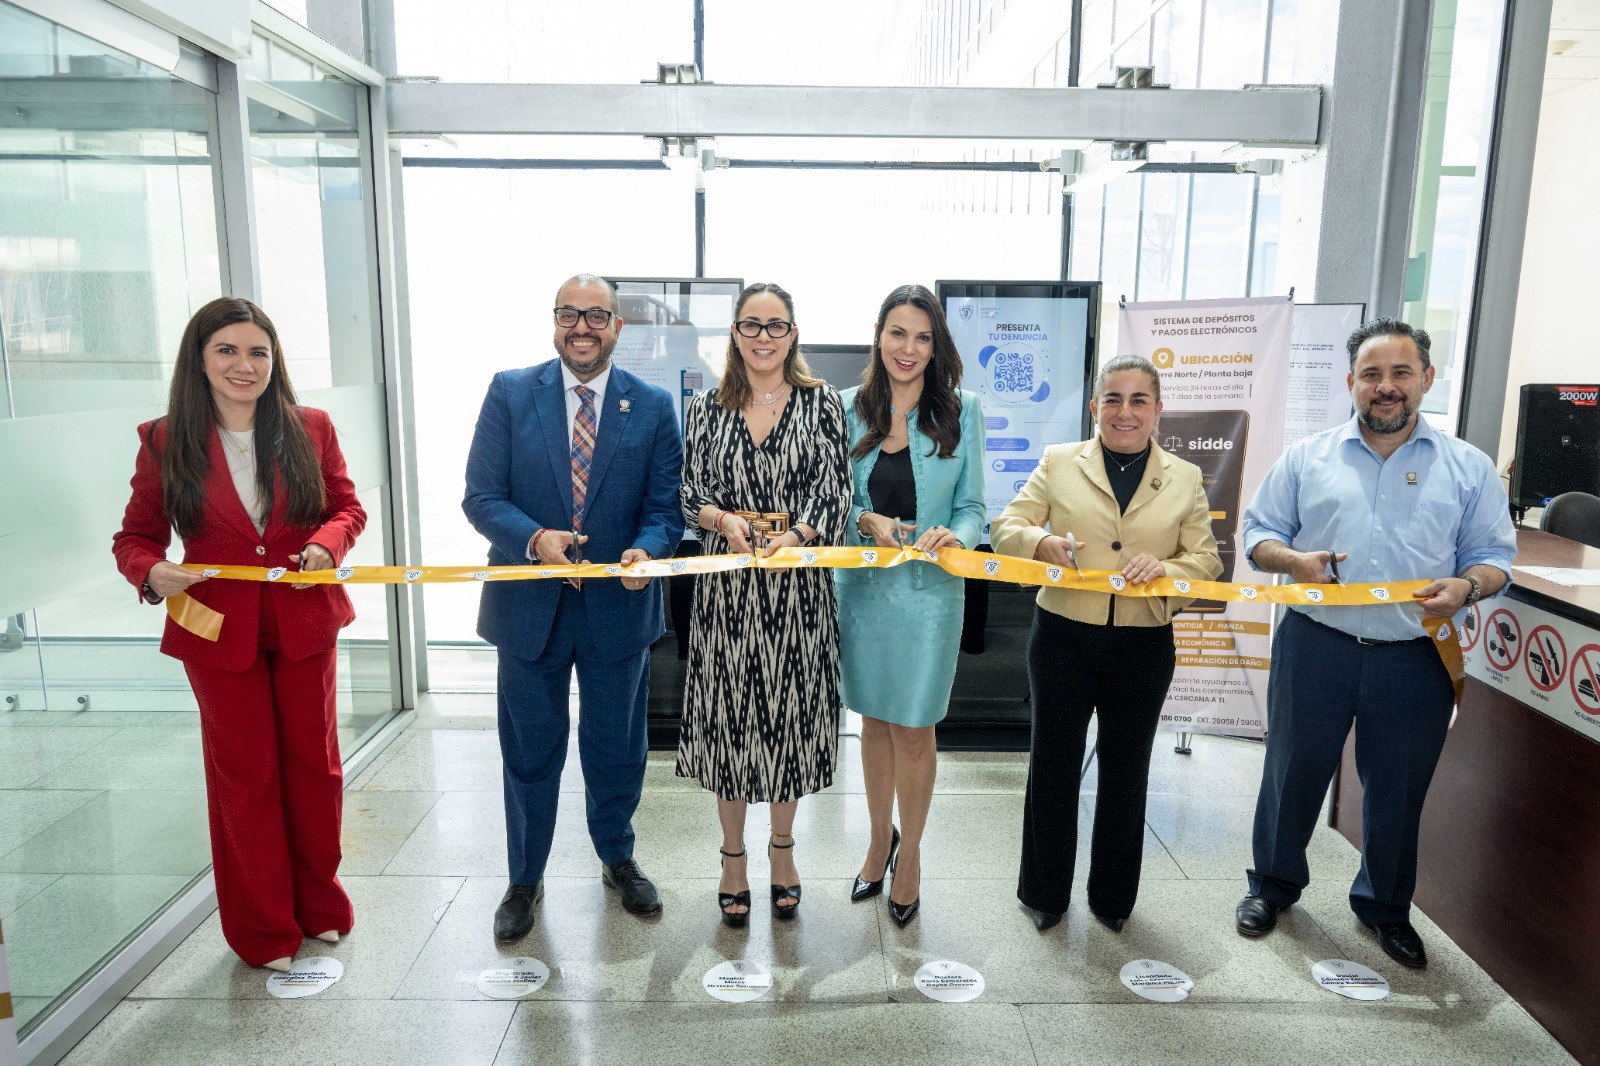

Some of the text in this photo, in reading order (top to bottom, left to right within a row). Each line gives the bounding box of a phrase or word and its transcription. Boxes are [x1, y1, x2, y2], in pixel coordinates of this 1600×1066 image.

[1153, 317, 1191, 325] SISTEMA
[1204, 314, 1255, 324] DEPÓSITOS
[996, 323, 1041, 332] PRESENTA
[1190, 325, 1257, 336] ELECTRÓNICOS
[988, 333, 1048, 341] TU DENUNCIA
[1180, 352, 1253, 365] UBICACIÓN
[1233, 369, 1253, 378] baja
[1559, 391, 1598, 401] 2000W
[1188, 437, 1234, 450] sidde
[1181, 638, 1226, 647] ECONÓMICA
[1181, 656, 1228, 664] REPARACIÓN
[1201, 678, 1241, 686] ayudamos
[1174, 695, 1210, 703] CERCANA
[1174, 715, 1192, 723] 0700
